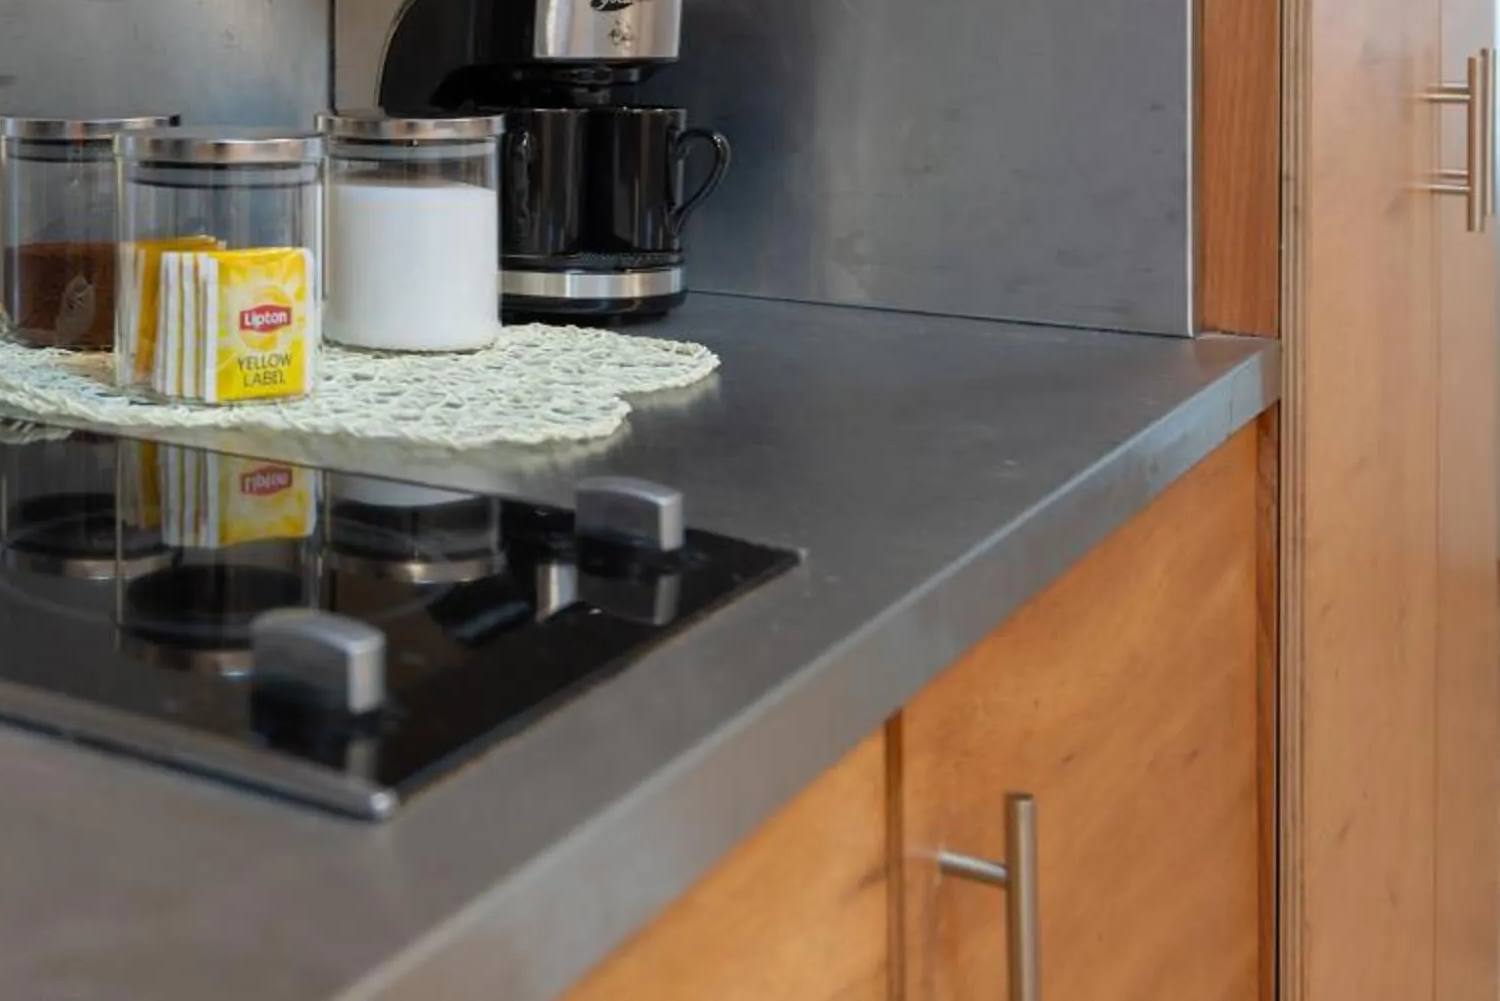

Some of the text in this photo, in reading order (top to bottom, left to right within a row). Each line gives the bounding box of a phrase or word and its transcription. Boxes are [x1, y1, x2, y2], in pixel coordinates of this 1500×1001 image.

[242, 310, 289, 328] Lipton
[237, 353, 292, 372] YELLOW
[243, 369, 286, 388] LABEL
